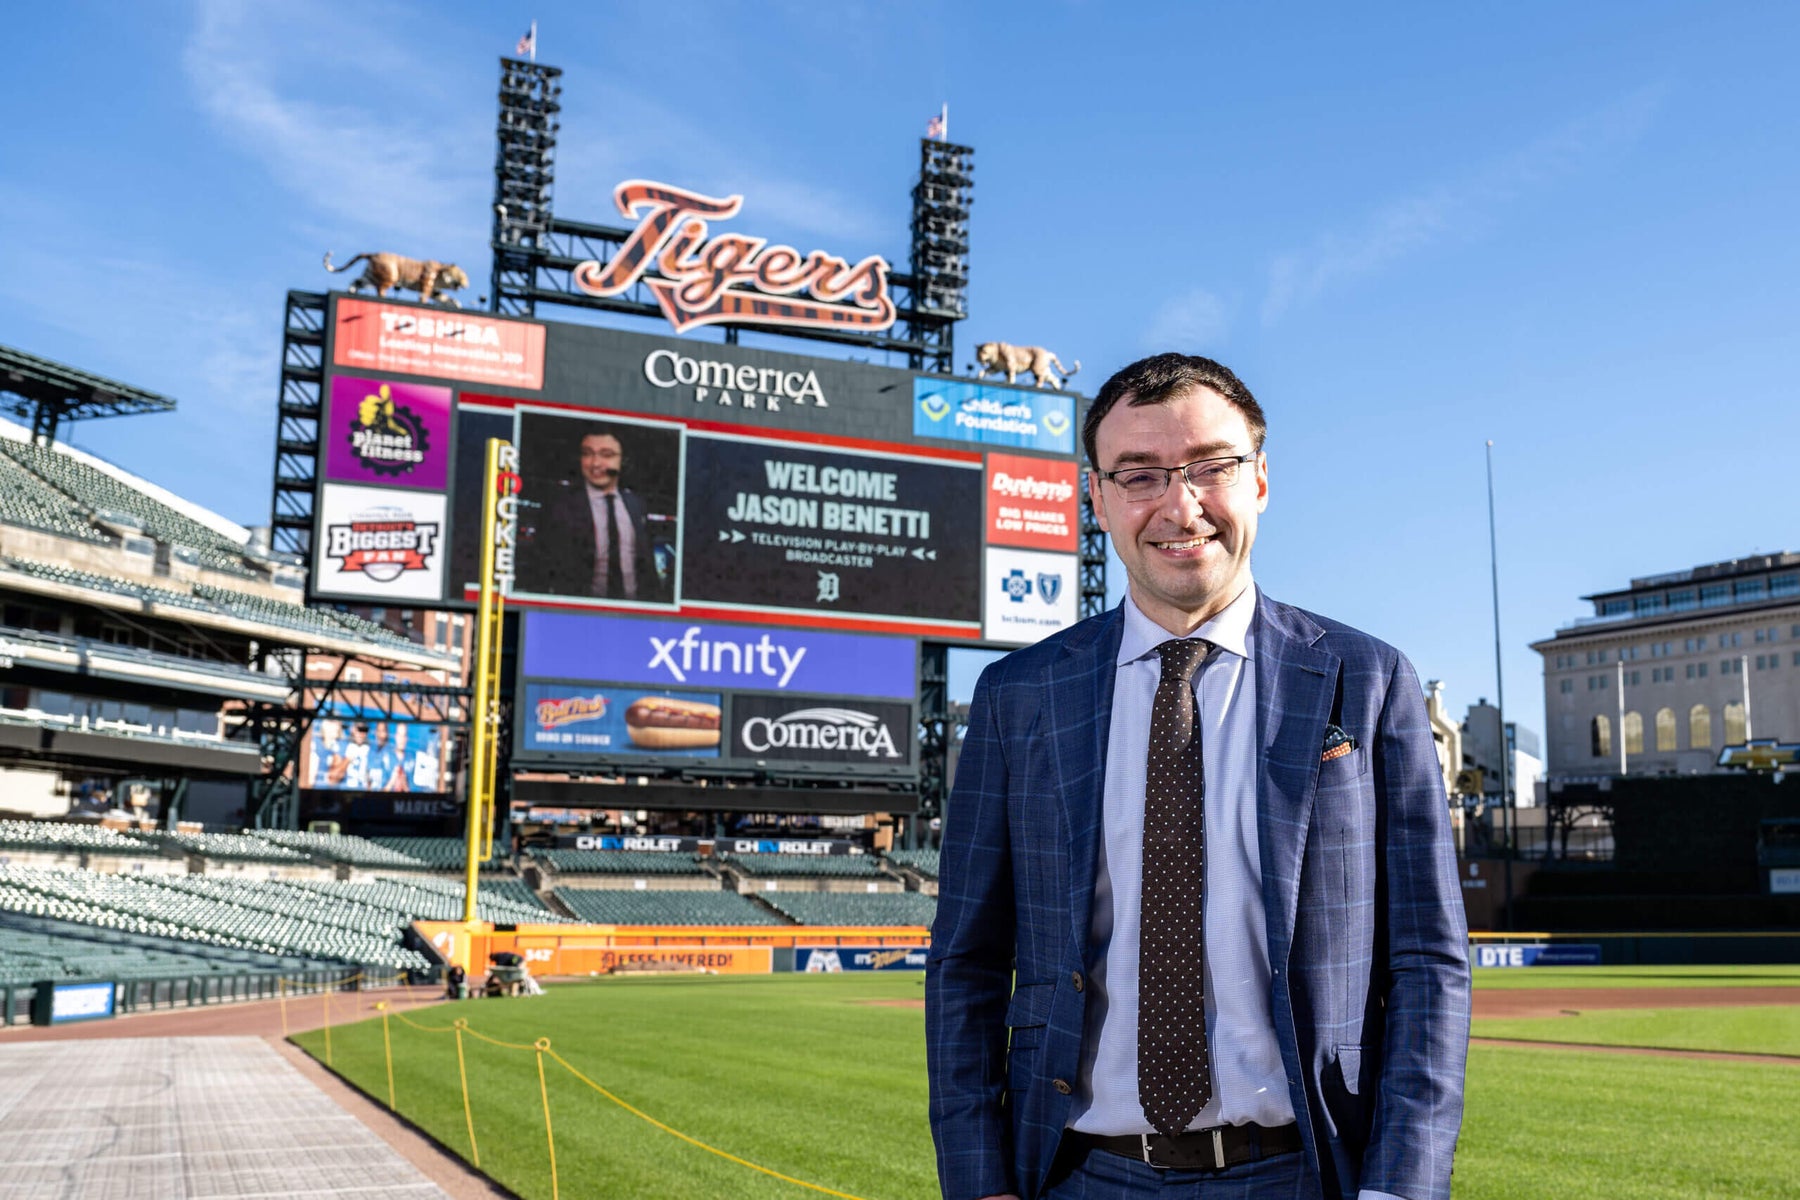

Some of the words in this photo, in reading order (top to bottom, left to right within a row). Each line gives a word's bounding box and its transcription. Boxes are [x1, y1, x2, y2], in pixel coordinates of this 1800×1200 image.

[574, 179, 897, 333] Tigers
[380, 312, 500, 346] TOSHIBA
[695, 386, 780, 411] PARK
[955, 411, 1038, 435] Foundation
[352, 429, 412, 449] planet
[360, 444, 423, 462] fitness
[764, 460, 897, 501] WELCOME
[991, 472, 1074, 499] Dunham's
[494, 445, 523, 596] ROCKET
[727, 493, 818, 528] JASON
[822, 501, 929, 539] BENETTI
[330, 524, 438, 557] BIGGEST
[751, 532, 822, 549] TELEVISION
[824, 539, 907, 558] PLAY-BY-PLAY
[363, 551, 406, 562] FAN
[785, 550, 873, 568] BROADCASTER
[816, 570, 840, 603] D
[647, 627, 807, 687] xfinity
[576, 836, 681, 852] CHEVROLET
[735, 839, 833, 854] CHEVROLET
[1481, 947, 1524, 966] DTE
